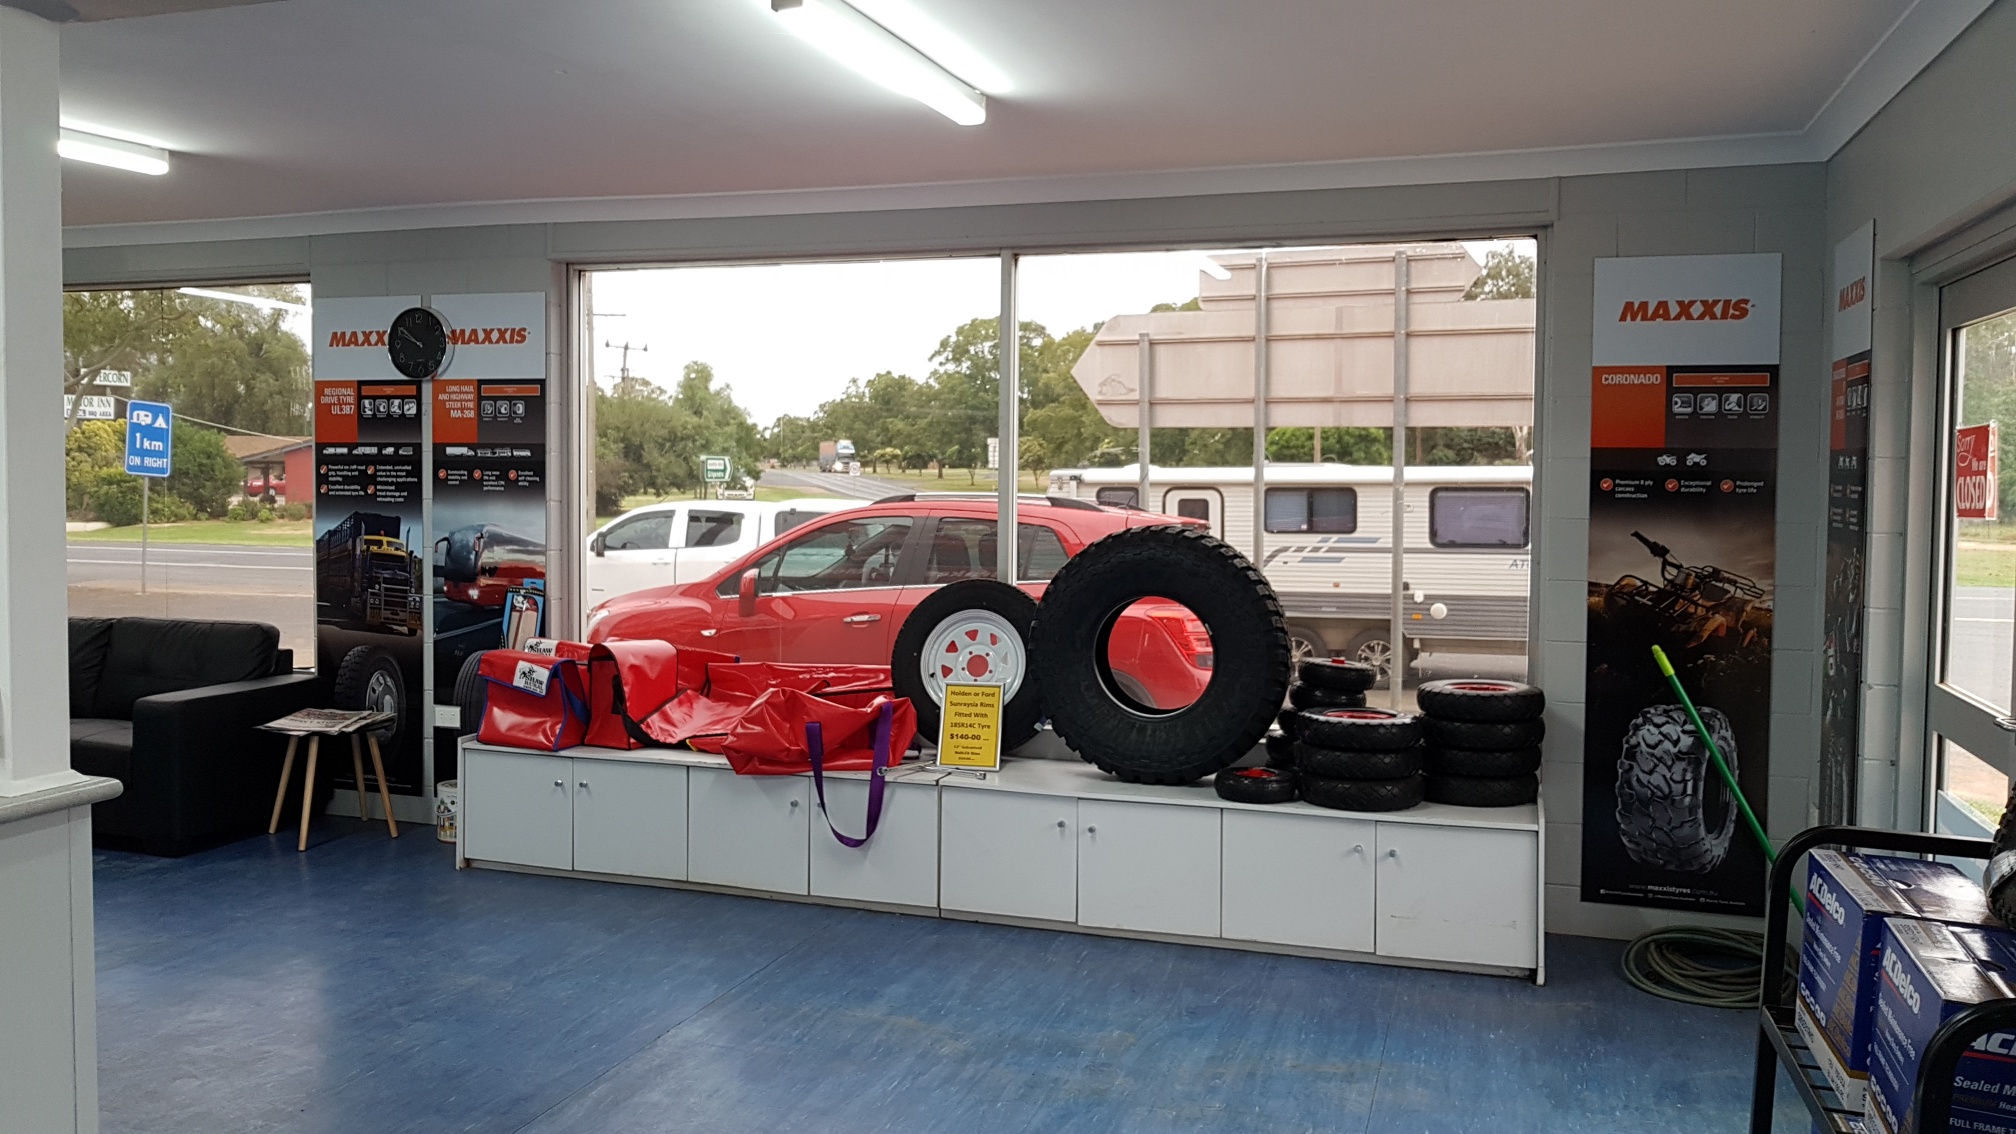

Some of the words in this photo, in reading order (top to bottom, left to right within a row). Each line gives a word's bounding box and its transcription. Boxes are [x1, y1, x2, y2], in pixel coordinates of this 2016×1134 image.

[1619, 298, 1751, 322] MAXXIS
[329, 330, 388, 347] MAXX
[434, 325, 441, 335] 2
[449, 327, 528, 345] MAXXIS
[1602, 374, 1661, 385] CORONADO
[324, 387, 355, 395] REGIONAL
[97, 397, 112, 408] INN
[320, 396, 339, 404] DRIVE
[340, 396, 355, 404] TYRE
[331, 405, 355, 415] UL387
[135, 432, 140, 448] 1
[143, 438, 163, 451] km
[129, 455, 140, 466] ON
[144, 456, 168, 468] RIGHT
[1956, 475, 1986, 509] CLOSED
[949, 700, 978, 708] Sunraysia
[1809, 872, 1846, 926] ACDelco
[1882, 946, 1921, 1015] ACDelco
[1953, 1076, 2001, 1094] Sealed
[1949, 1117, 1971, 1129] FULL
[1973, 1121, 2007, 1134] FRAME
